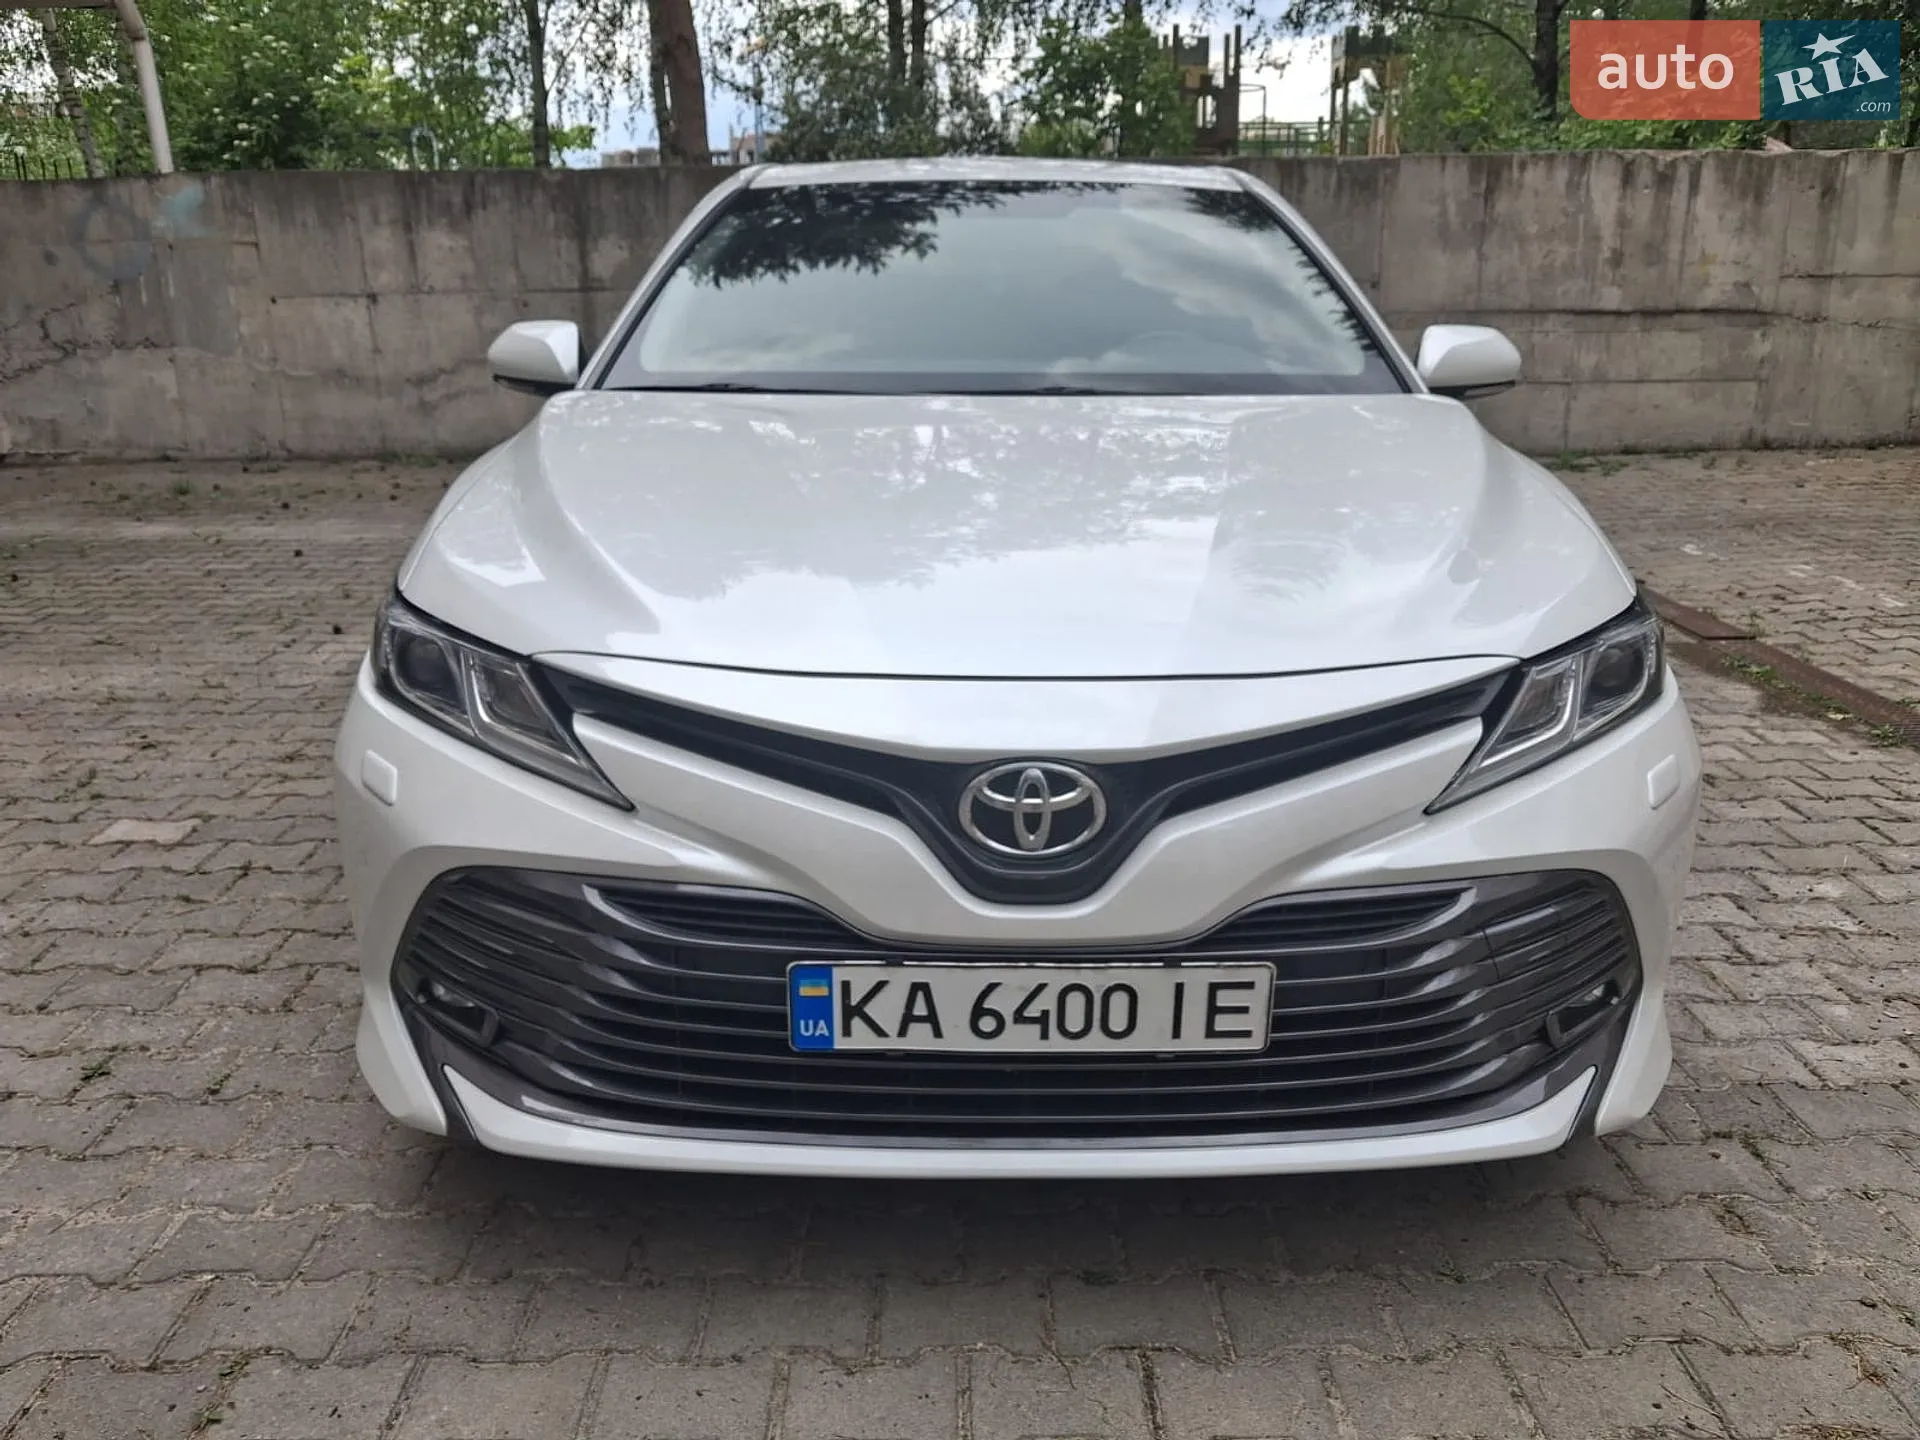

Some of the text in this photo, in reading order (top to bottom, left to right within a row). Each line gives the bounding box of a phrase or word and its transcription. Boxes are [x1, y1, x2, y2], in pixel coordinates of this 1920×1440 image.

[800, 1018, 830, 1038] UA
[840, 979, 1256, 1041] KA 6400 IE
